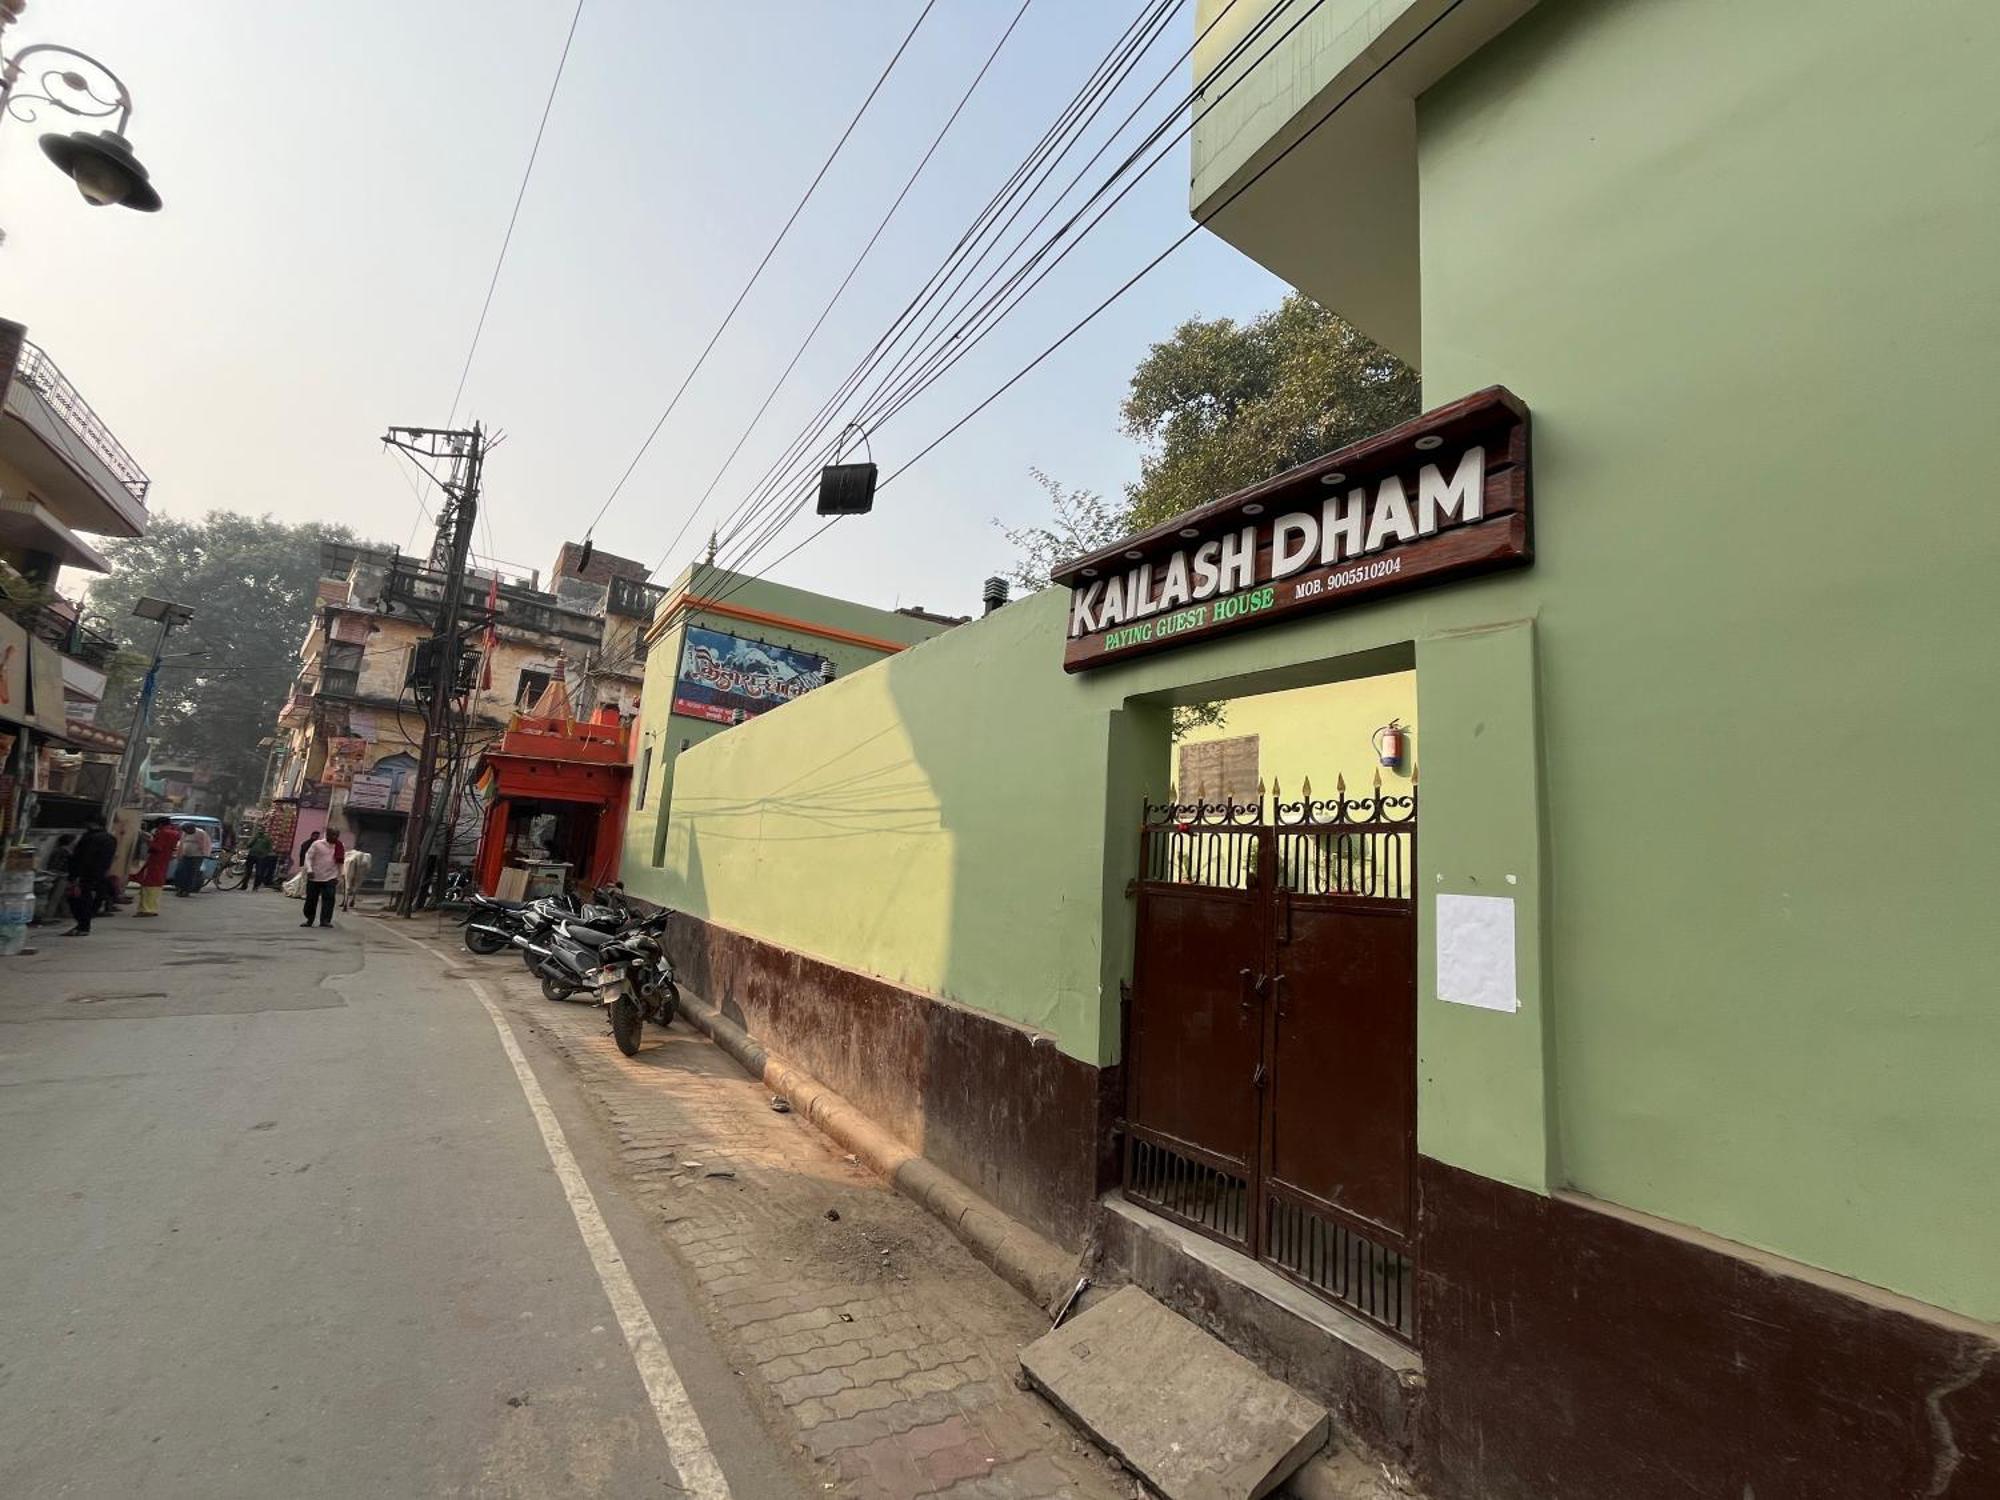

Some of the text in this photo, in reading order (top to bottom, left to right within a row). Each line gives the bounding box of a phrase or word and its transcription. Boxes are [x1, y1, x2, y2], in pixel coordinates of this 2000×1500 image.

[1071, 446, 1486, 638] KAILASH DHAM
[1295, 556, 1401, 600] MOB. 9005510204
[1104, 587, 1275, 651] PAYING GUEST HOUSE
